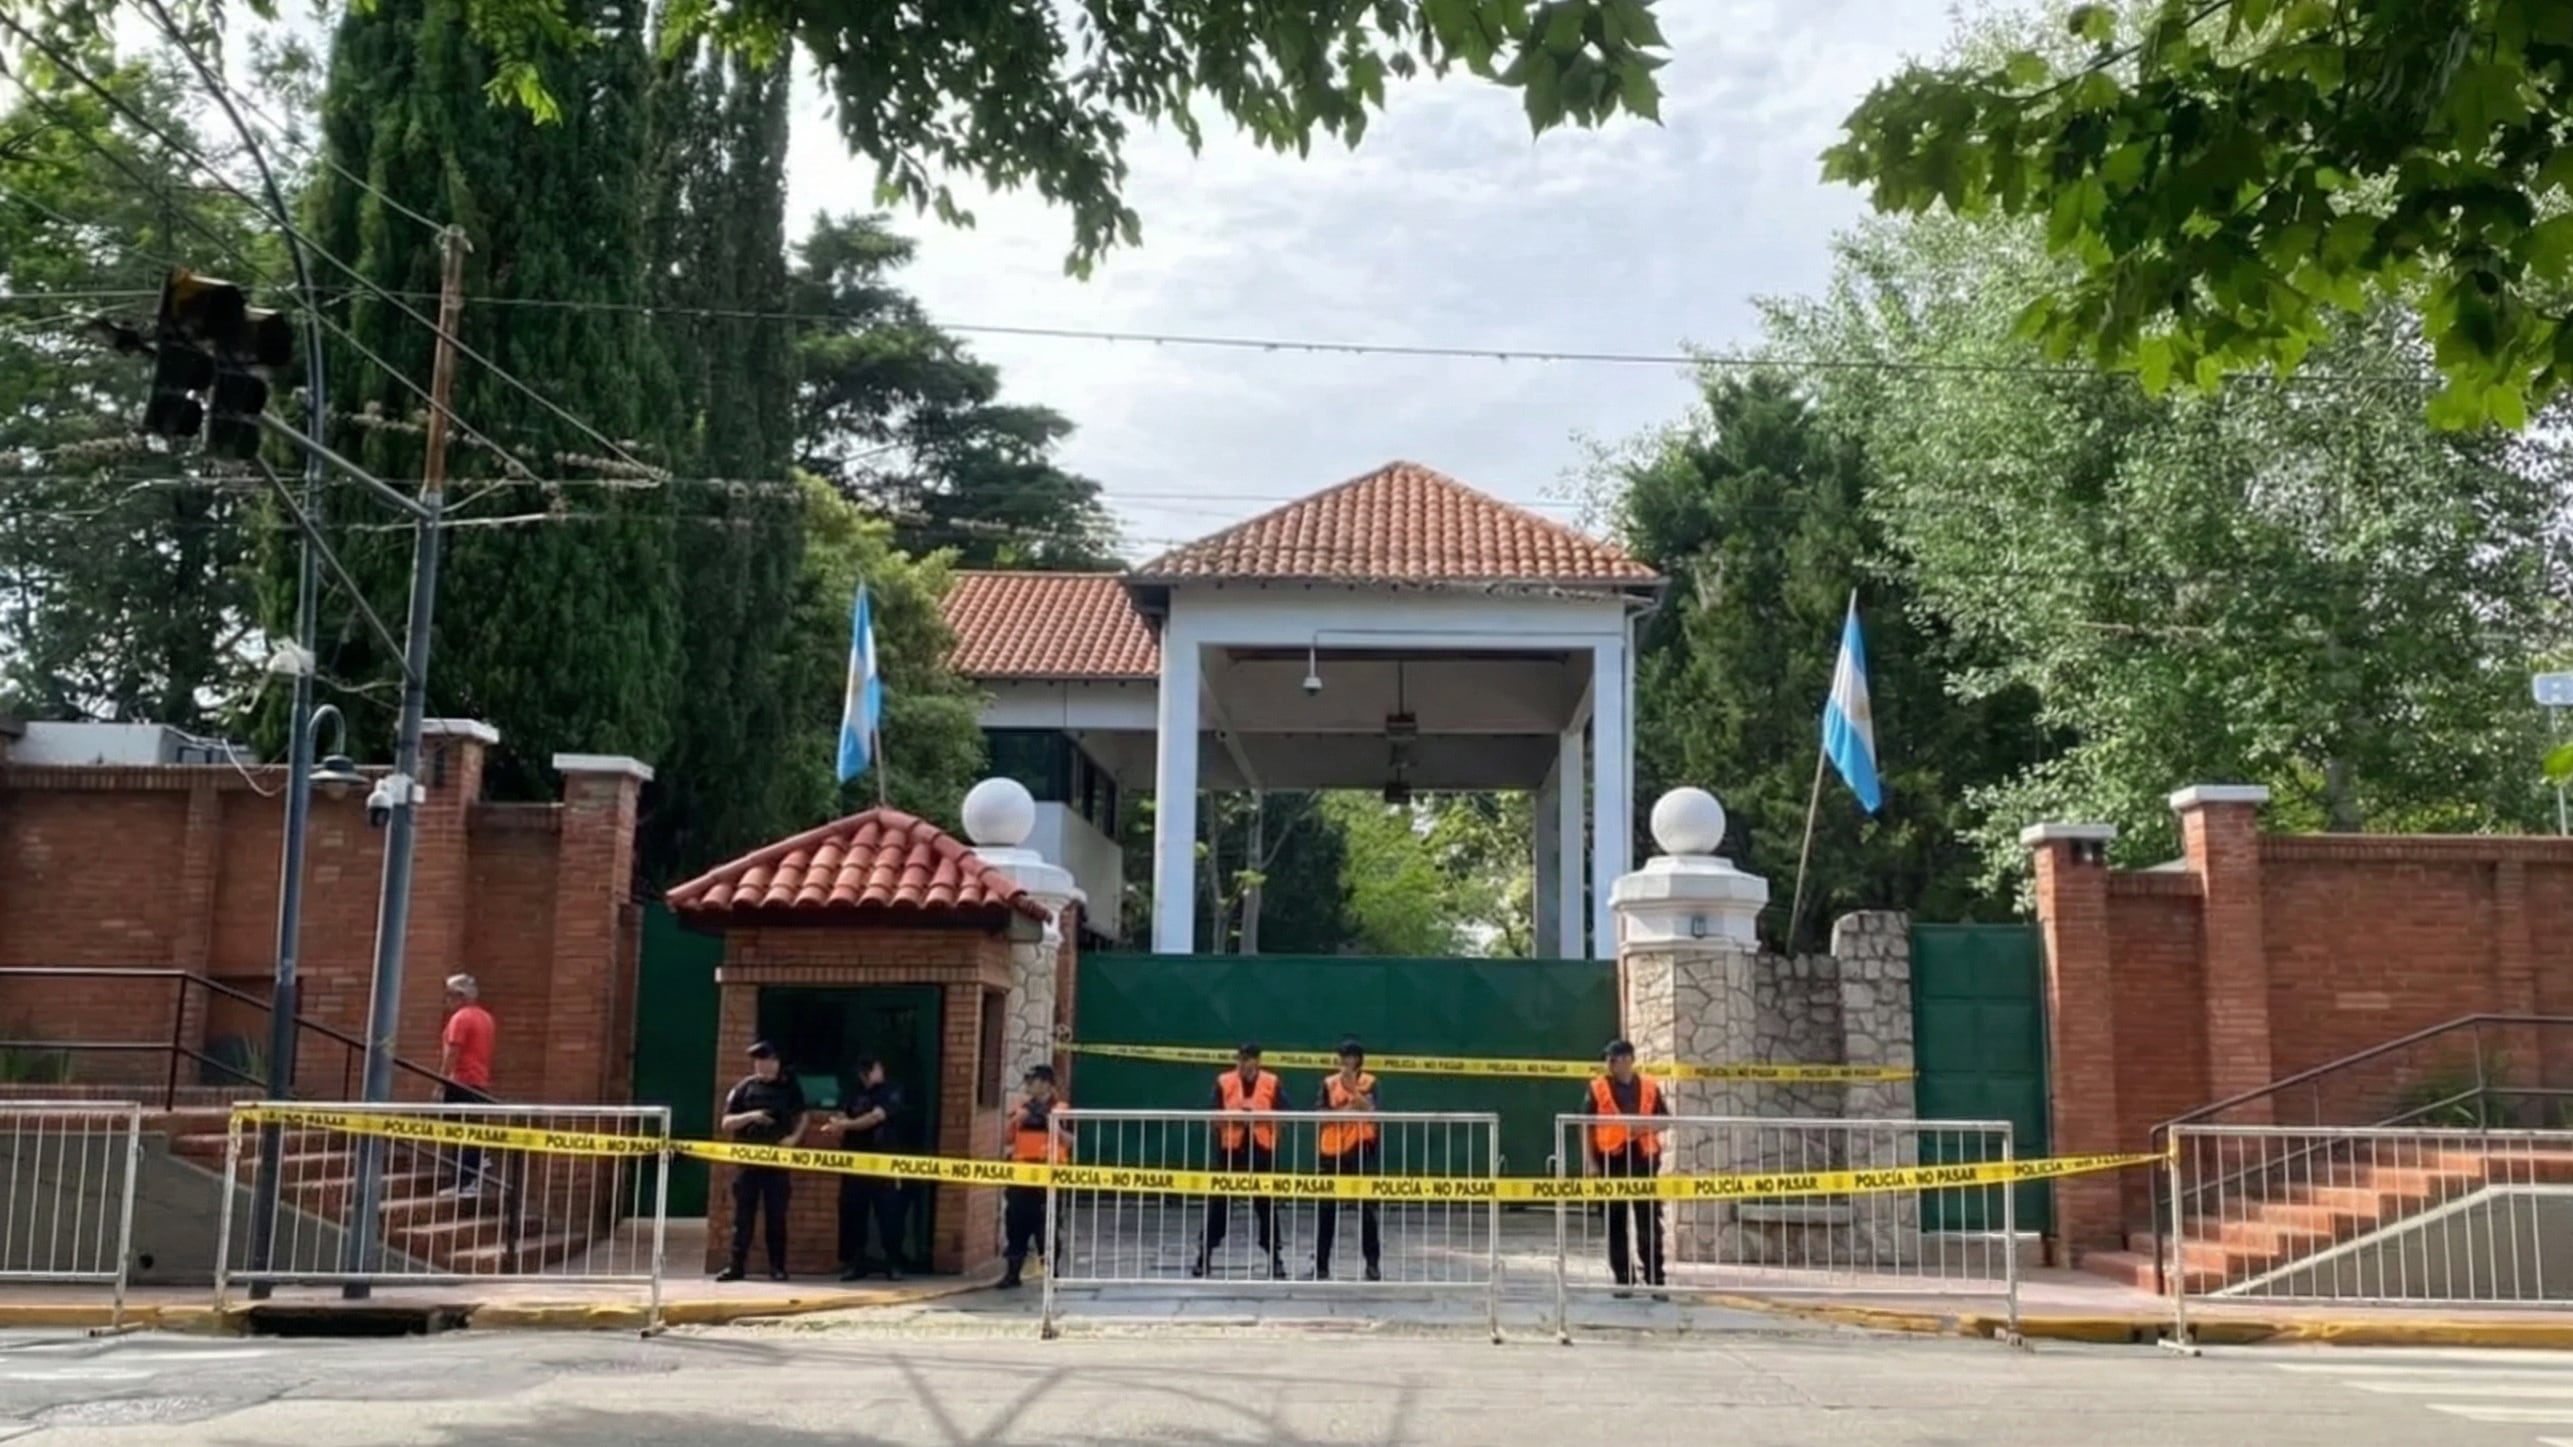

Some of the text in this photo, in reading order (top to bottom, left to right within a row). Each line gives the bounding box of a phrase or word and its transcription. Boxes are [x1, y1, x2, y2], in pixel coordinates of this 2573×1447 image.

[445, 1125, 464, 1139] NO
[467, 1127, 508, 1143] PASAR
[607, 1139, 626, 1151] NO
[791, 1152, 811, 1165] NO
[812, 1154, 855, 1168] PASAR
[951, 1165, 970, 1178] NO
[973, 1165, 1016, 1181] PASAR
[1112, 1173, 1130, 1187] NO
[1133, 1174, 1174, 1188] PASAR
[1915, 1170, 1934, 1185] NO
[1937, 1167, 1977, 1182] PASAR
[1273, 1179, 1292, 1192] NO
[1294, 1179, 1335, 1194] PASAR
[1433, 1182, 1451, 1196] NO
[1454, 1182, 1497, 1197] PASAR
[1594, 1182, 1613, 1197] NO
[1617, 1182, 1657, 1197] PASAR
[1755, 1179, 1774, 1193] NO
[1777, 1177, 1818, 1191] PASAR
